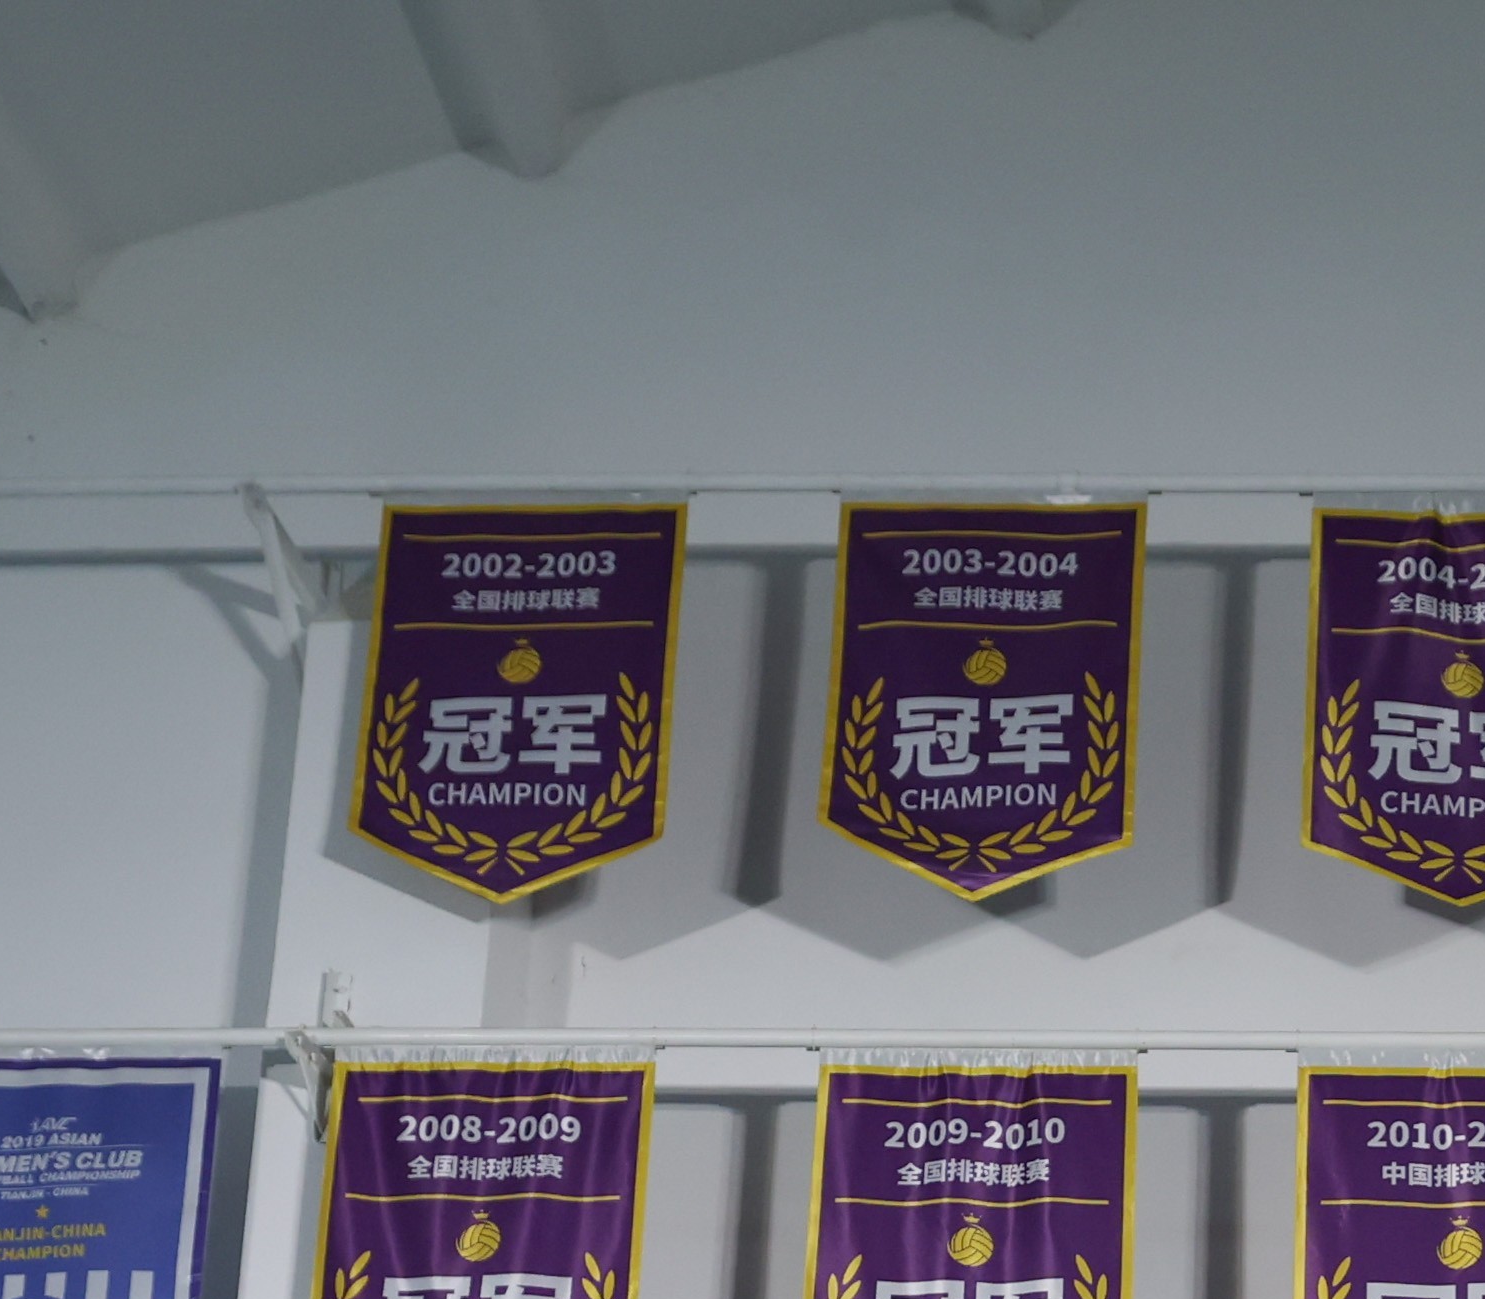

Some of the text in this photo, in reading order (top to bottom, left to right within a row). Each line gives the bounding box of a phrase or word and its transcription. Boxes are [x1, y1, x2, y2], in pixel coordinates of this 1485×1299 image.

[442, 551, 615, 578] 2002-2003
[902, 549, 1078, 578] 2003-2004
[452, 587, 600, 611] 全国排球联赛
[914, 586, 1063, 611] 全国排球联赛
[418, 694, 606, 774] 冠军
[890, 694, 1073, 779] 冠军
[429, 783, 586, 806] CHAMPION
[901, 784, 1056, 810] CHAMPION
[0, 1132, 102, 1149] 2019 ASIAN
[397, 1113, 580, 1143] 2008-2009
[885, 1118, 1065, 1150] 2009-2010
[75, 1149, 144, 1170] CLUB
[408, 1154, 563, 1180] 全国排球联赛
[898, 1158, 1049, 1187] 全国排球联赛
[39, 1169, 141, 1183] CHAMPIONSHIP
[52, 1186, 89, 1197] CHINA
